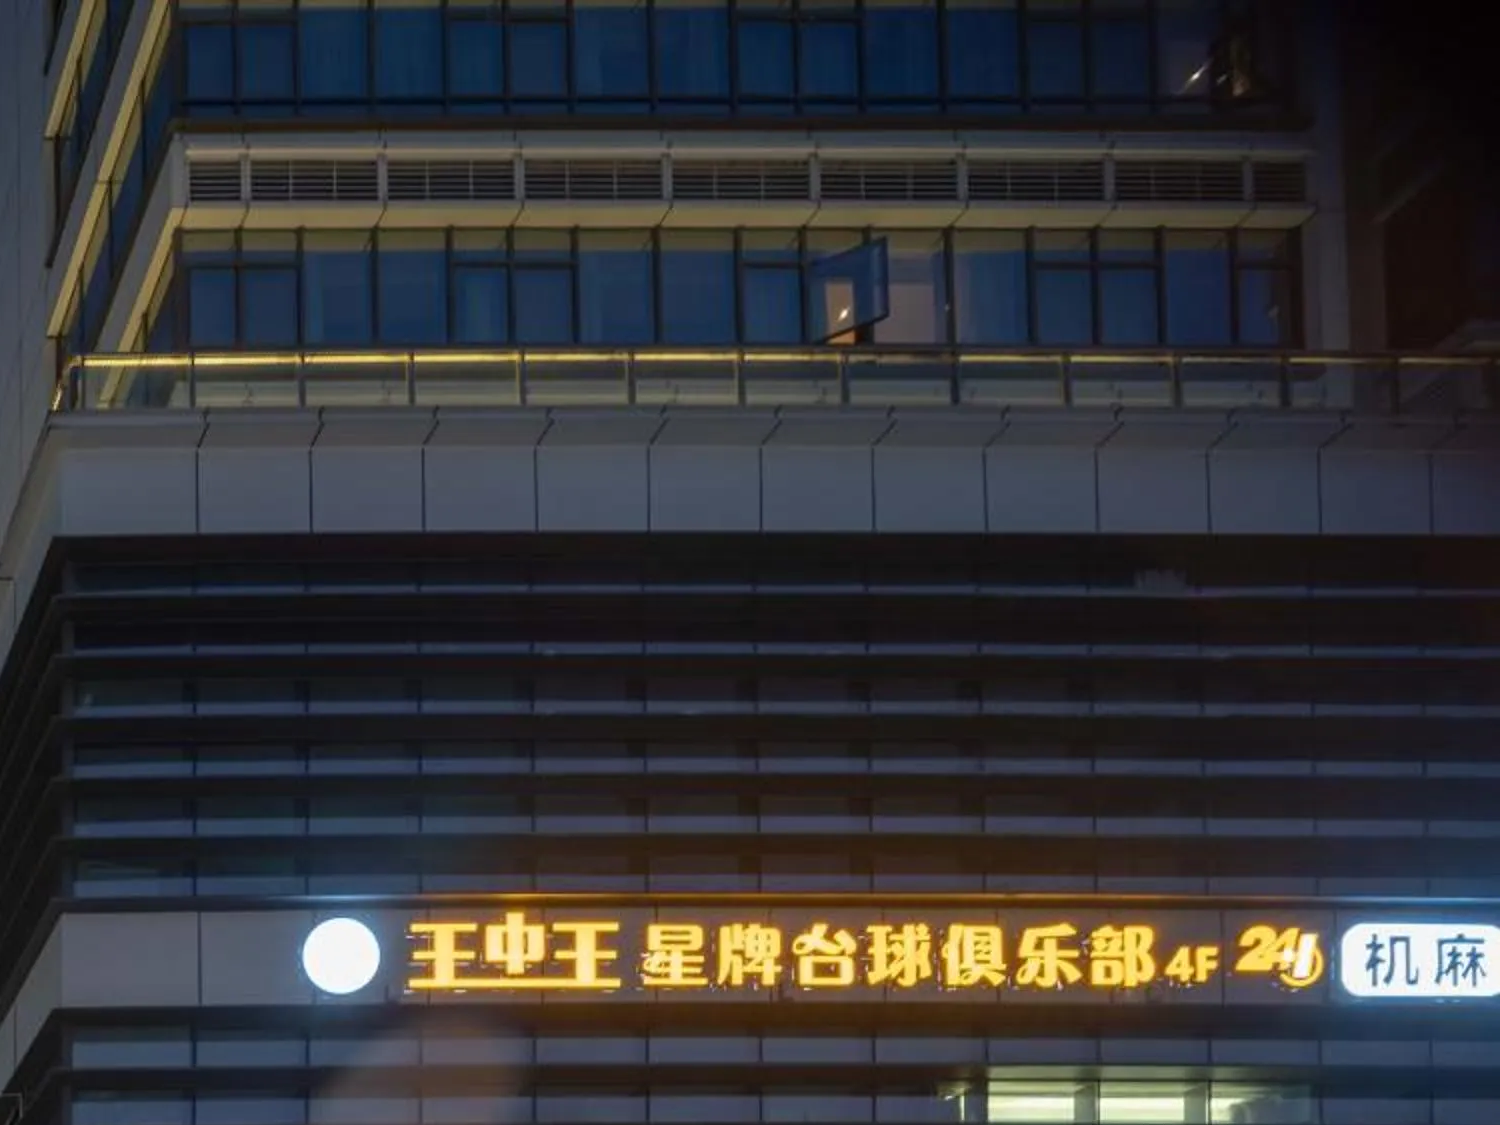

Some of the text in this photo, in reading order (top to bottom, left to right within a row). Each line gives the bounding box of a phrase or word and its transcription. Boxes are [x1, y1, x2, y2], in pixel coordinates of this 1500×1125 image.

[642, 922, 1157, 988] 星牌台球俱乐部
[1164, 945, 1218, 983] 4F
[1365, 933, 1487, 987] 机麻
